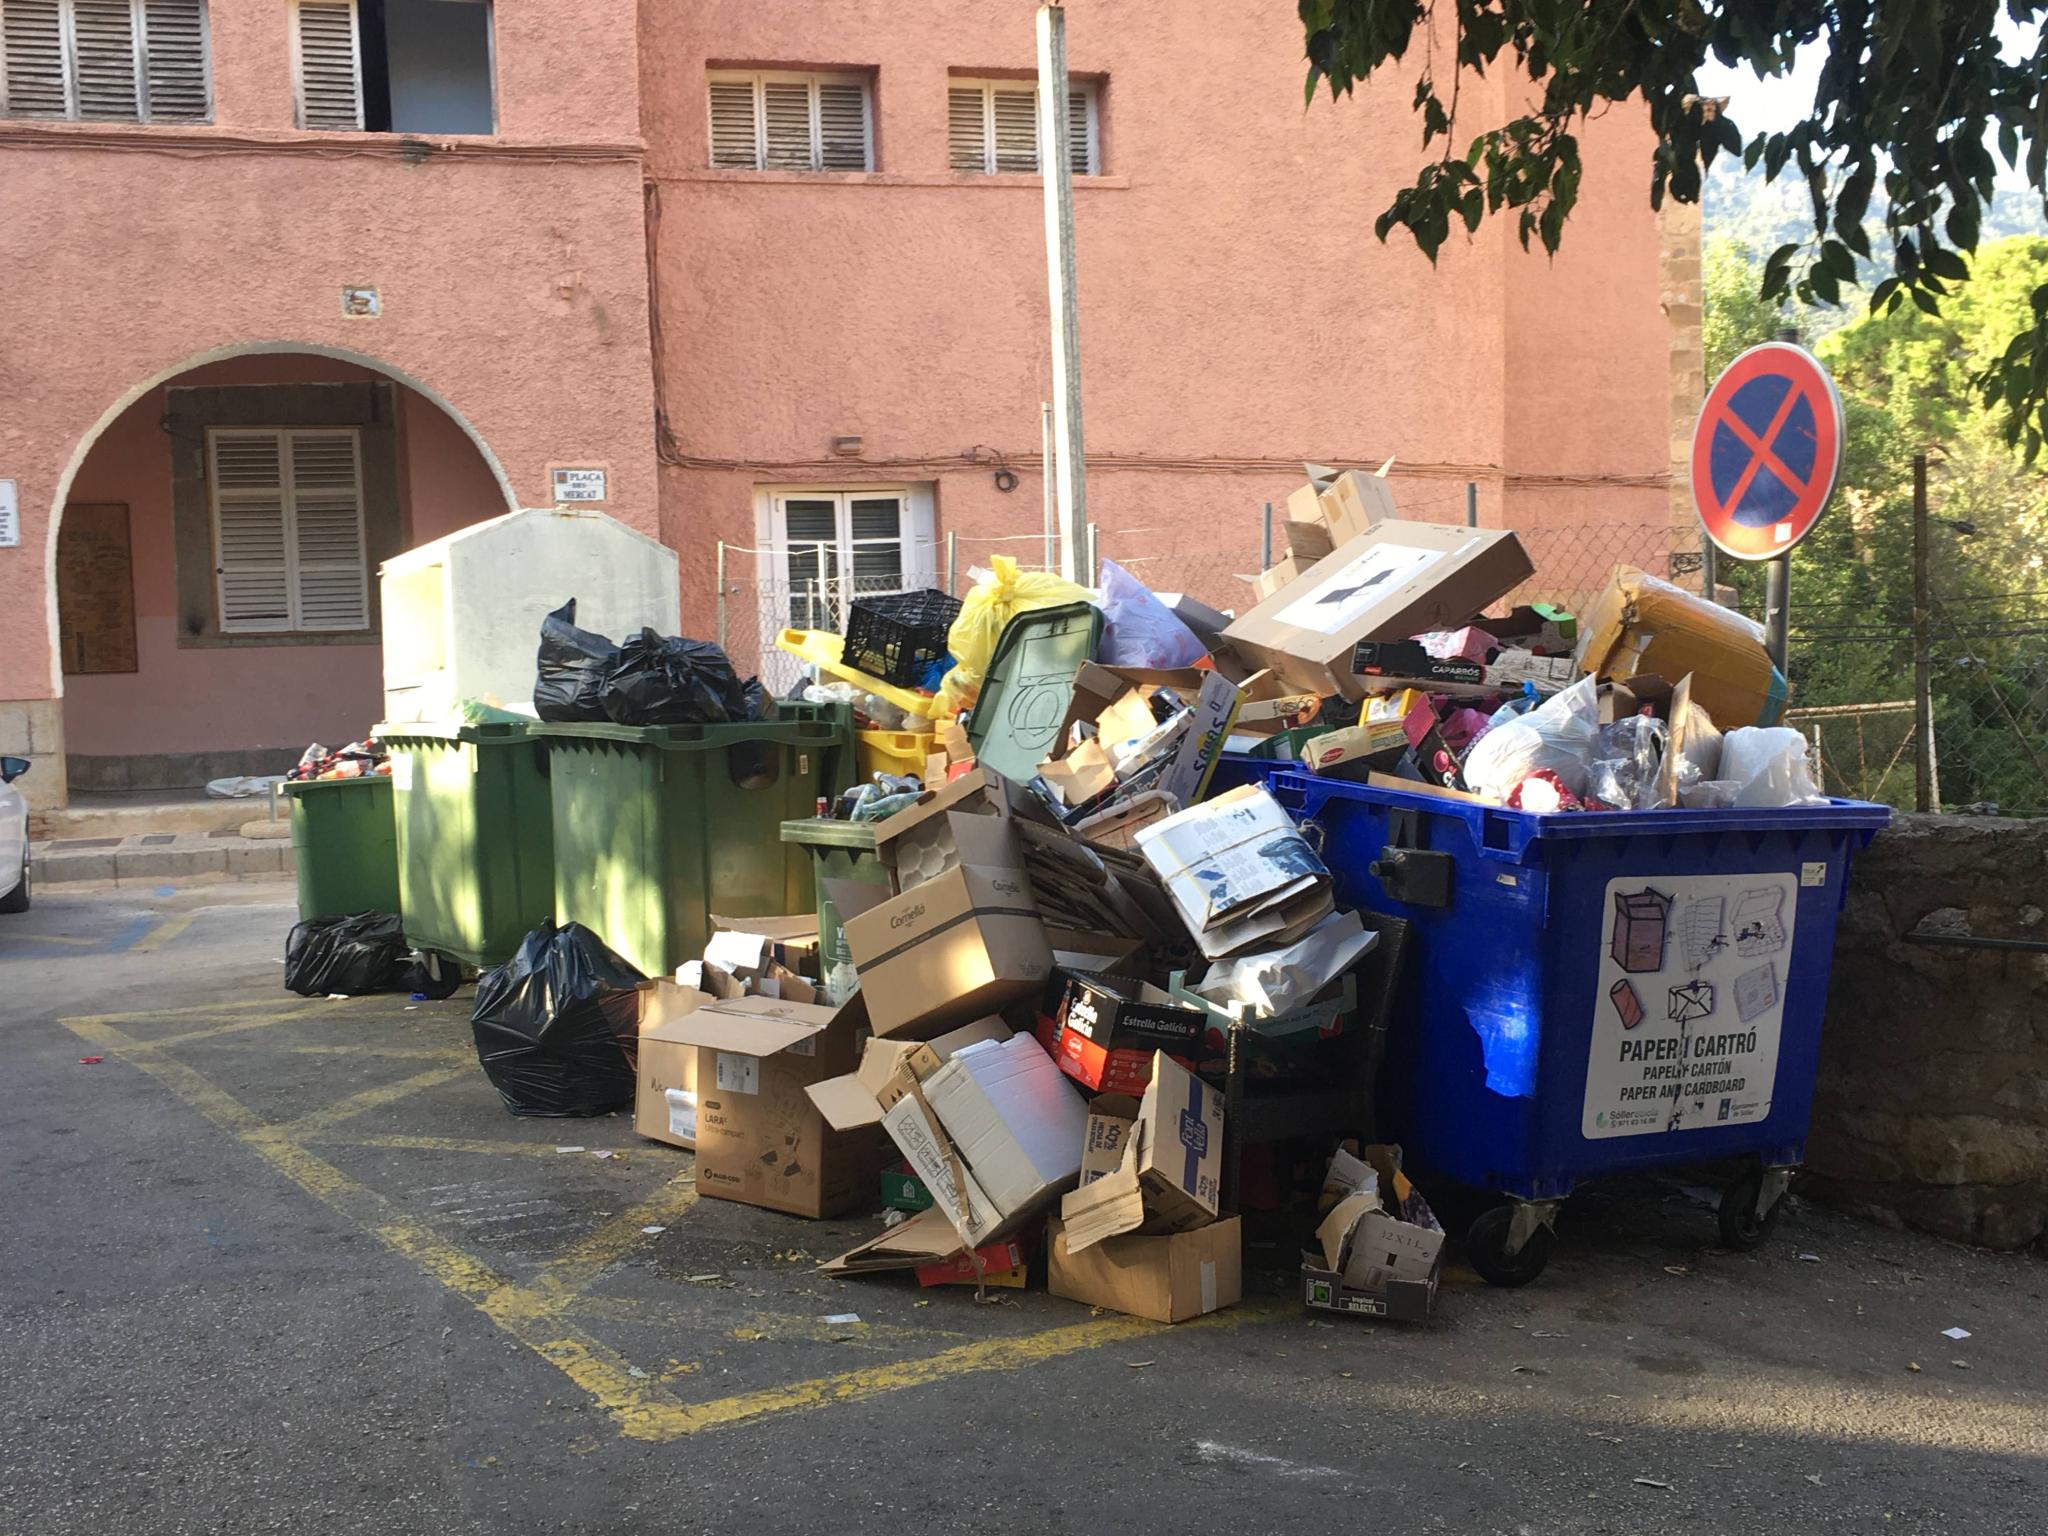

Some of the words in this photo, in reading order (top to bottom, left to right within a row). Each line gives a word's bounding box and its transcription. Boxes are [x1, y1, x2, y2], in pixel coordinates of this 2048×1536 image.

[569, 473, 602, 482] PLAÇA
[563, 490, 597, 498] MERCAT
[1432, 665, 1480, 676] CAPARRÓS
[1122, 1015, 1156, 1030] Estrella
[1157, 1020, 1187, 1034] Galicia
[1619, 1038, 1678, 1062] PAPER
[1682, 1036, 1690, 1058] I
[1694, 1026, 1757, 1057] CARTRÓ
[1643, 1065, 1679, 1081] PAPEL
[1691, 1058, 1732, 1077] CARTÓN
[1620, 1085, 1656, 1101] PAPER
[1659, 1083, 1682, 1098] AND
[1684, 1077, 1746, 1096] CARDBOARD
[1103, 1123, 1121, 1152] 100%
[1181, 1112, 1193, 1147] Font
[1194, 1122, 1206, 1151] Vella
[1348, 1302, 1377, 1314] SELECTA
